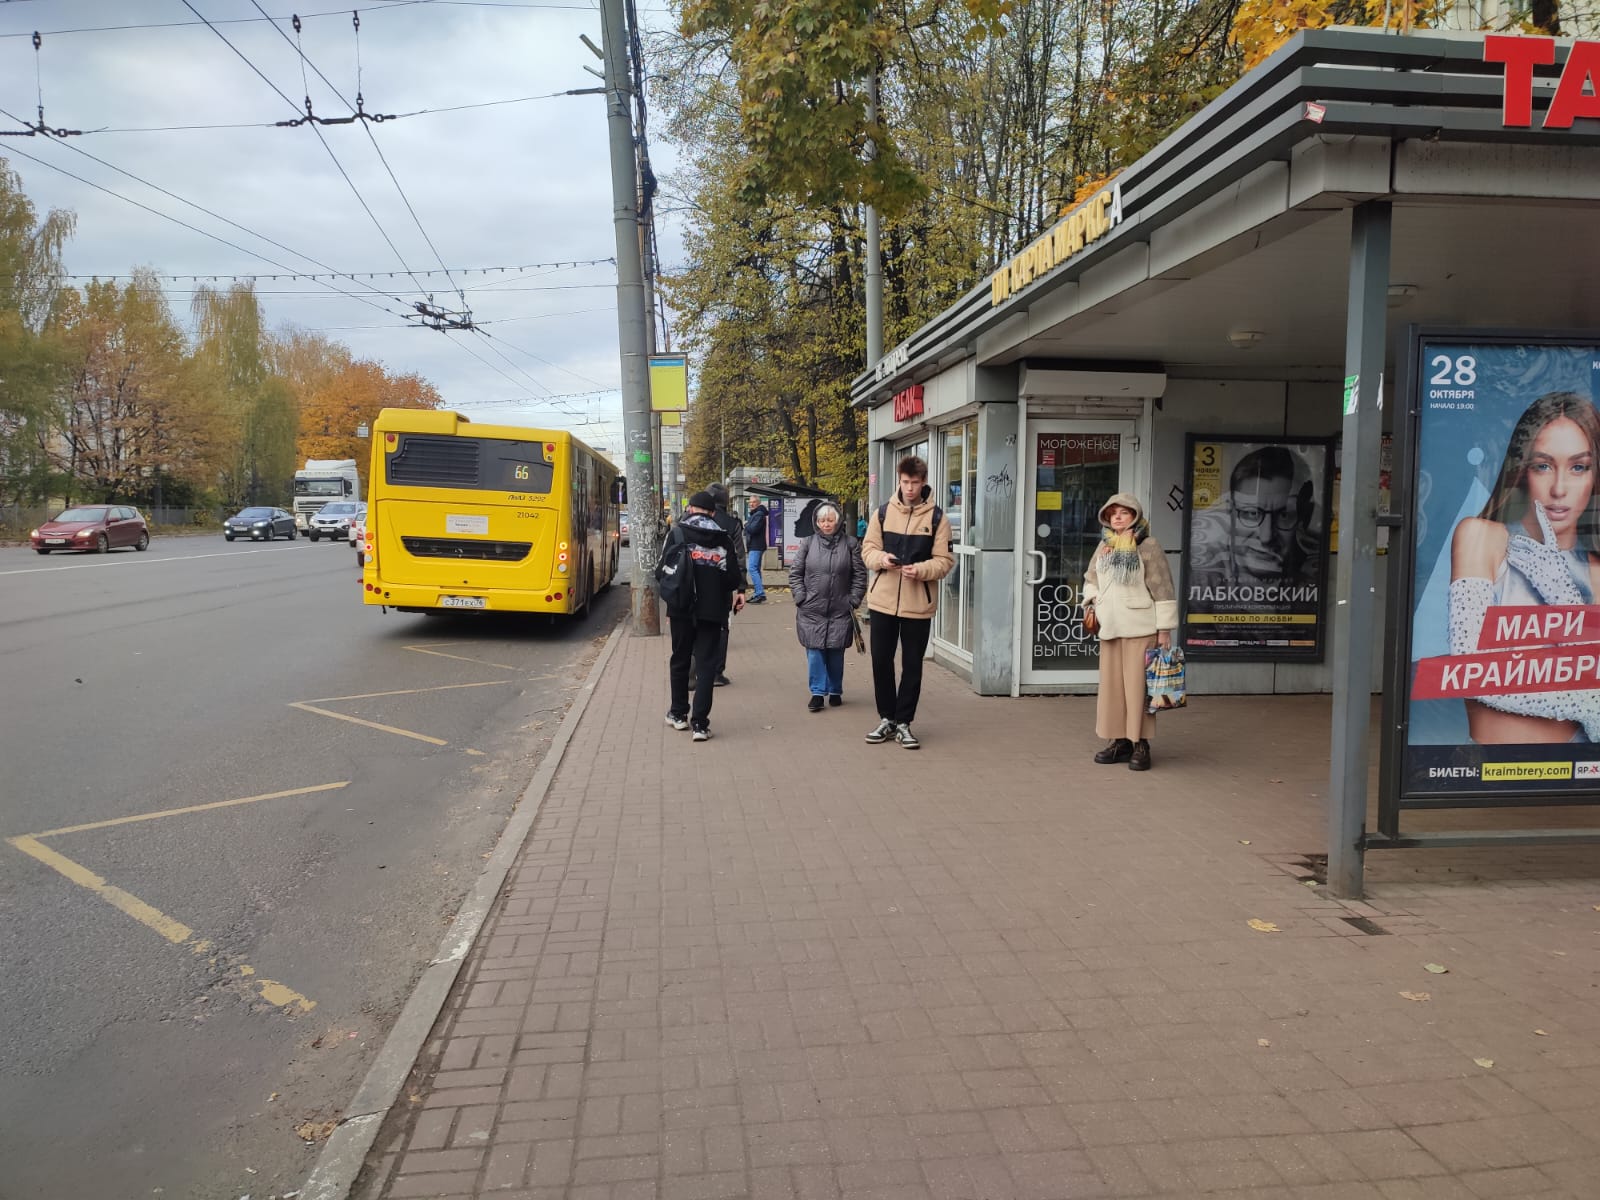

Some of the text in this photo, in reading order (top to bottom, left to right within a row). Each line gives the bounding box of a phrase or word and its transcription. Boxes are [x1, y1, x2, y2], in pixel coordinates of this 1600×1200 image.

[1054, 182, 1123, 266] МАРКСА
[1430, 355, 1477, 386] 28
[892, 385, 923, 422] ТАБАК
[1430, 389, 1475, 399] ОКТЯБРЯ
[1040, 439, 1119, 450] МОРОЖЕНОЕ
[1202, 446, 1215, 466] 3
[514, 465, 529, 480] 66
[517, 511, 540, 519] 21042
[1188, 584, 1318, 602] ЛАБКОВСКИЙ
[1038, 604, 1084, 625] ВОД
[1037, 622, 1100, 642] КОФ
[1495, 610, 1586, 642] МАРИ
[1034, 644, 1100, 656] ВЫПЕЧК
[1441, 652, 1600, 691] КРАЙМБР
[1429, 766, 1480, 778] БИЛЕТЫ:
[1484, 763, 1570, 778] kraimbrery.com
